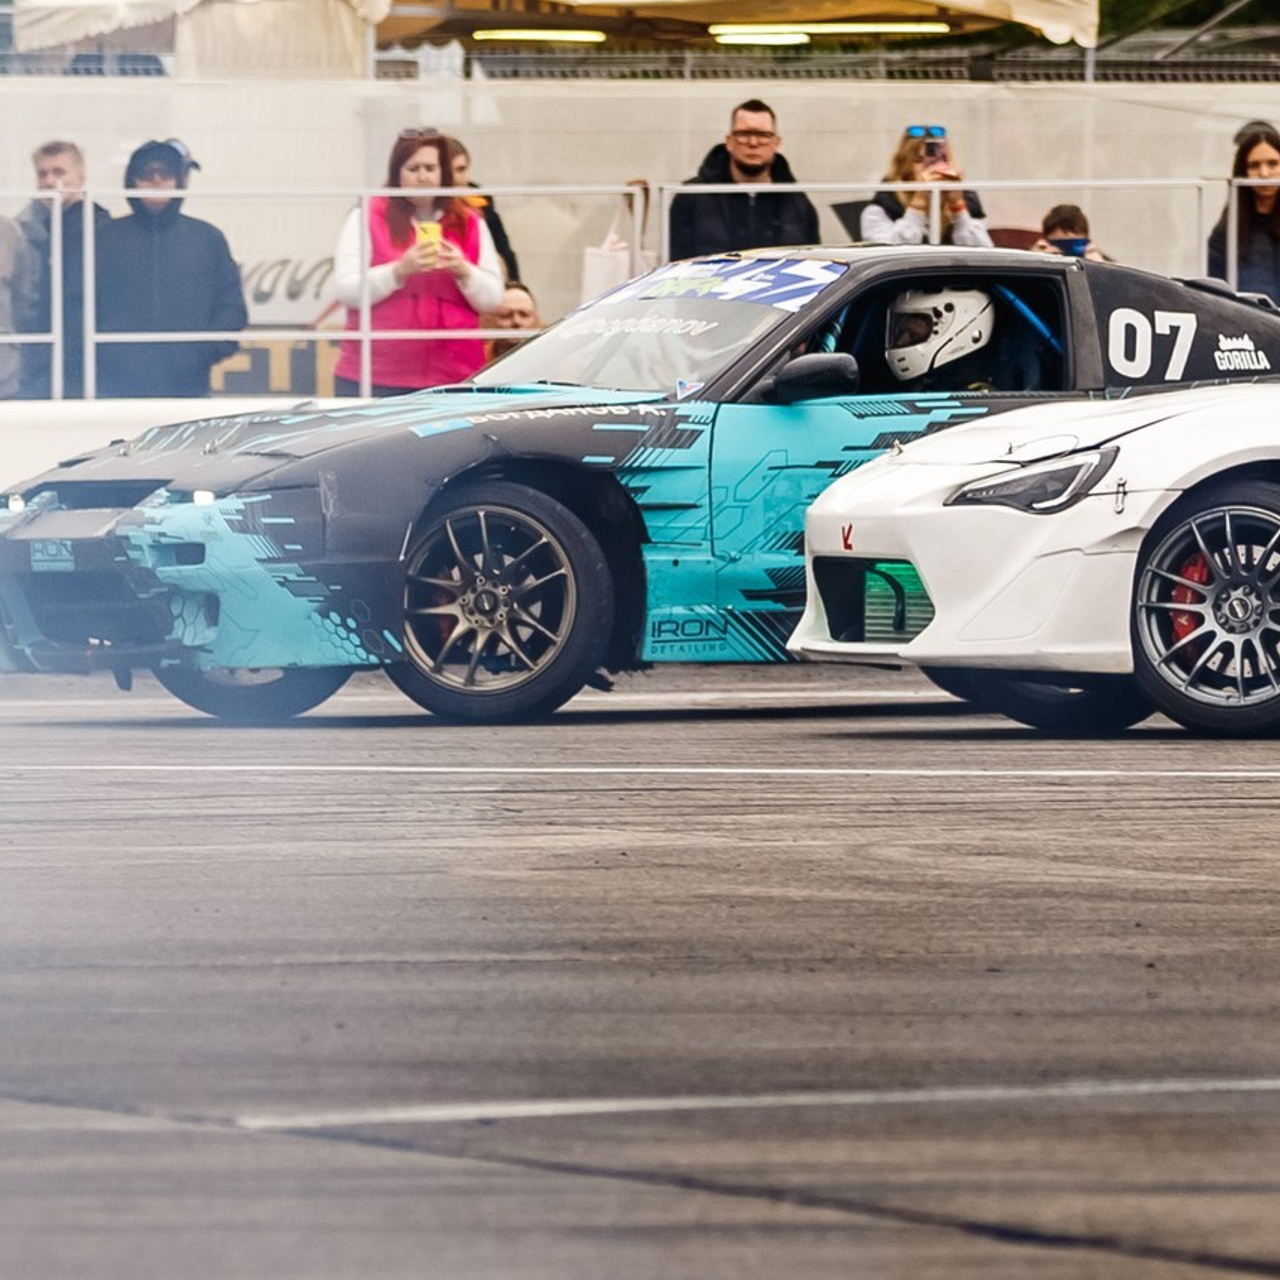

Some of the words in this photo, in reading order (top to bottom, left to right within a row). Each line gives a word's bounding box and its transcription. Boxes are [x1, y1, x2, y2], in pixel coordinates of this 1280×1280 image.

[1108, 307, 1199, 381] 07
[1213, 350, 1271, 371] GORILLA
[651, 618, 728, 638] IRON
